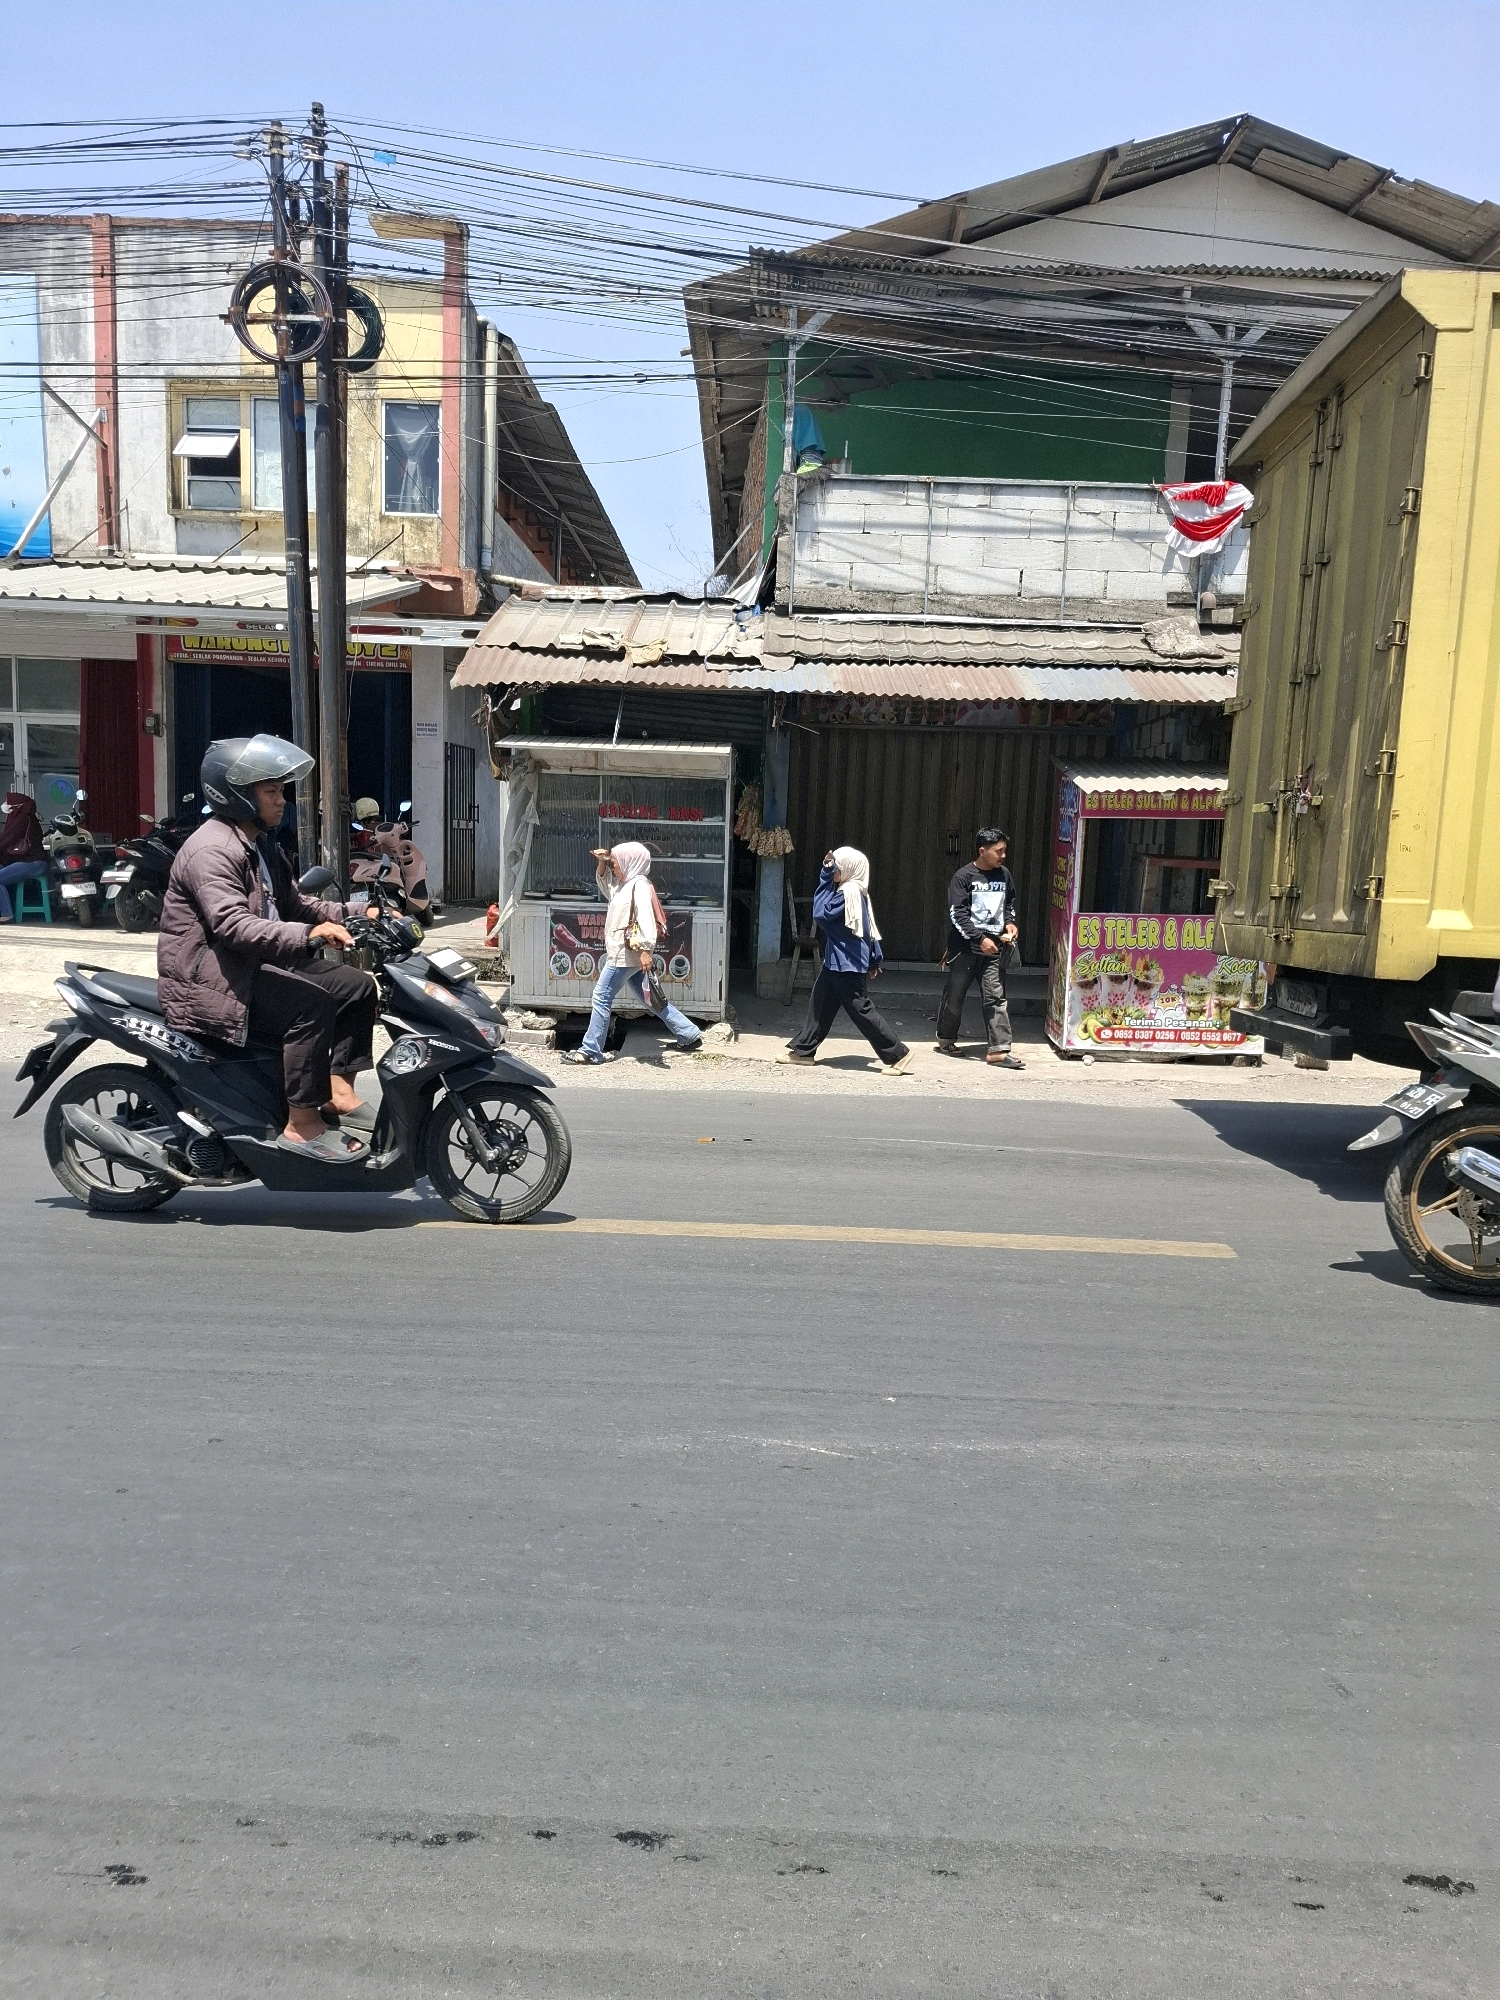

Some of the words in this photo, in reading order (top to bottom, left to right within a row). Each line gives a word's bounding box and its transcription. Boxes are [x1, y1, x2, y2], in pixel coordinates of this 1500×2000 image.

[182, 634, 279, 653] WARUNG
[1085, 793, 1099, 810] ES
[1101, 793, 1133, 810] TELER
[1136, 793, 1176, 811] SULTAN
[1180, 795, 1189, 811] &
[599, 803, 659, 819] WARUNG
[668, 806, 704, 821] NASI
[972, 882, 989, 891] The
[1077, 917, 1100, 948] ES
[1104, 917, 1160, 949] TELER
[1164, 917, 1177, 949] &
[1075, 951, 1132, 975] Sultan
[1160, 996, 1177, 1004] 10K
[1124, 1017, 1162, 1027] Terima
[1164, 1017, 1213, 1028] Pesanan
[128, 1017, 197, 1053] STREET
[1114, 1031, 1133, 1039] 0852
[1134, 1031, 1153, 1040] 8387
[1155, 1031, 1174, 1040] 0256
[1181, 1031, 1200, 1041] 0852
[1201, 1032, 1221, 1041] 6552
[1222, 1032, 1242, 1042] 0677
[428, 1038, 460, 1052] HONDA
